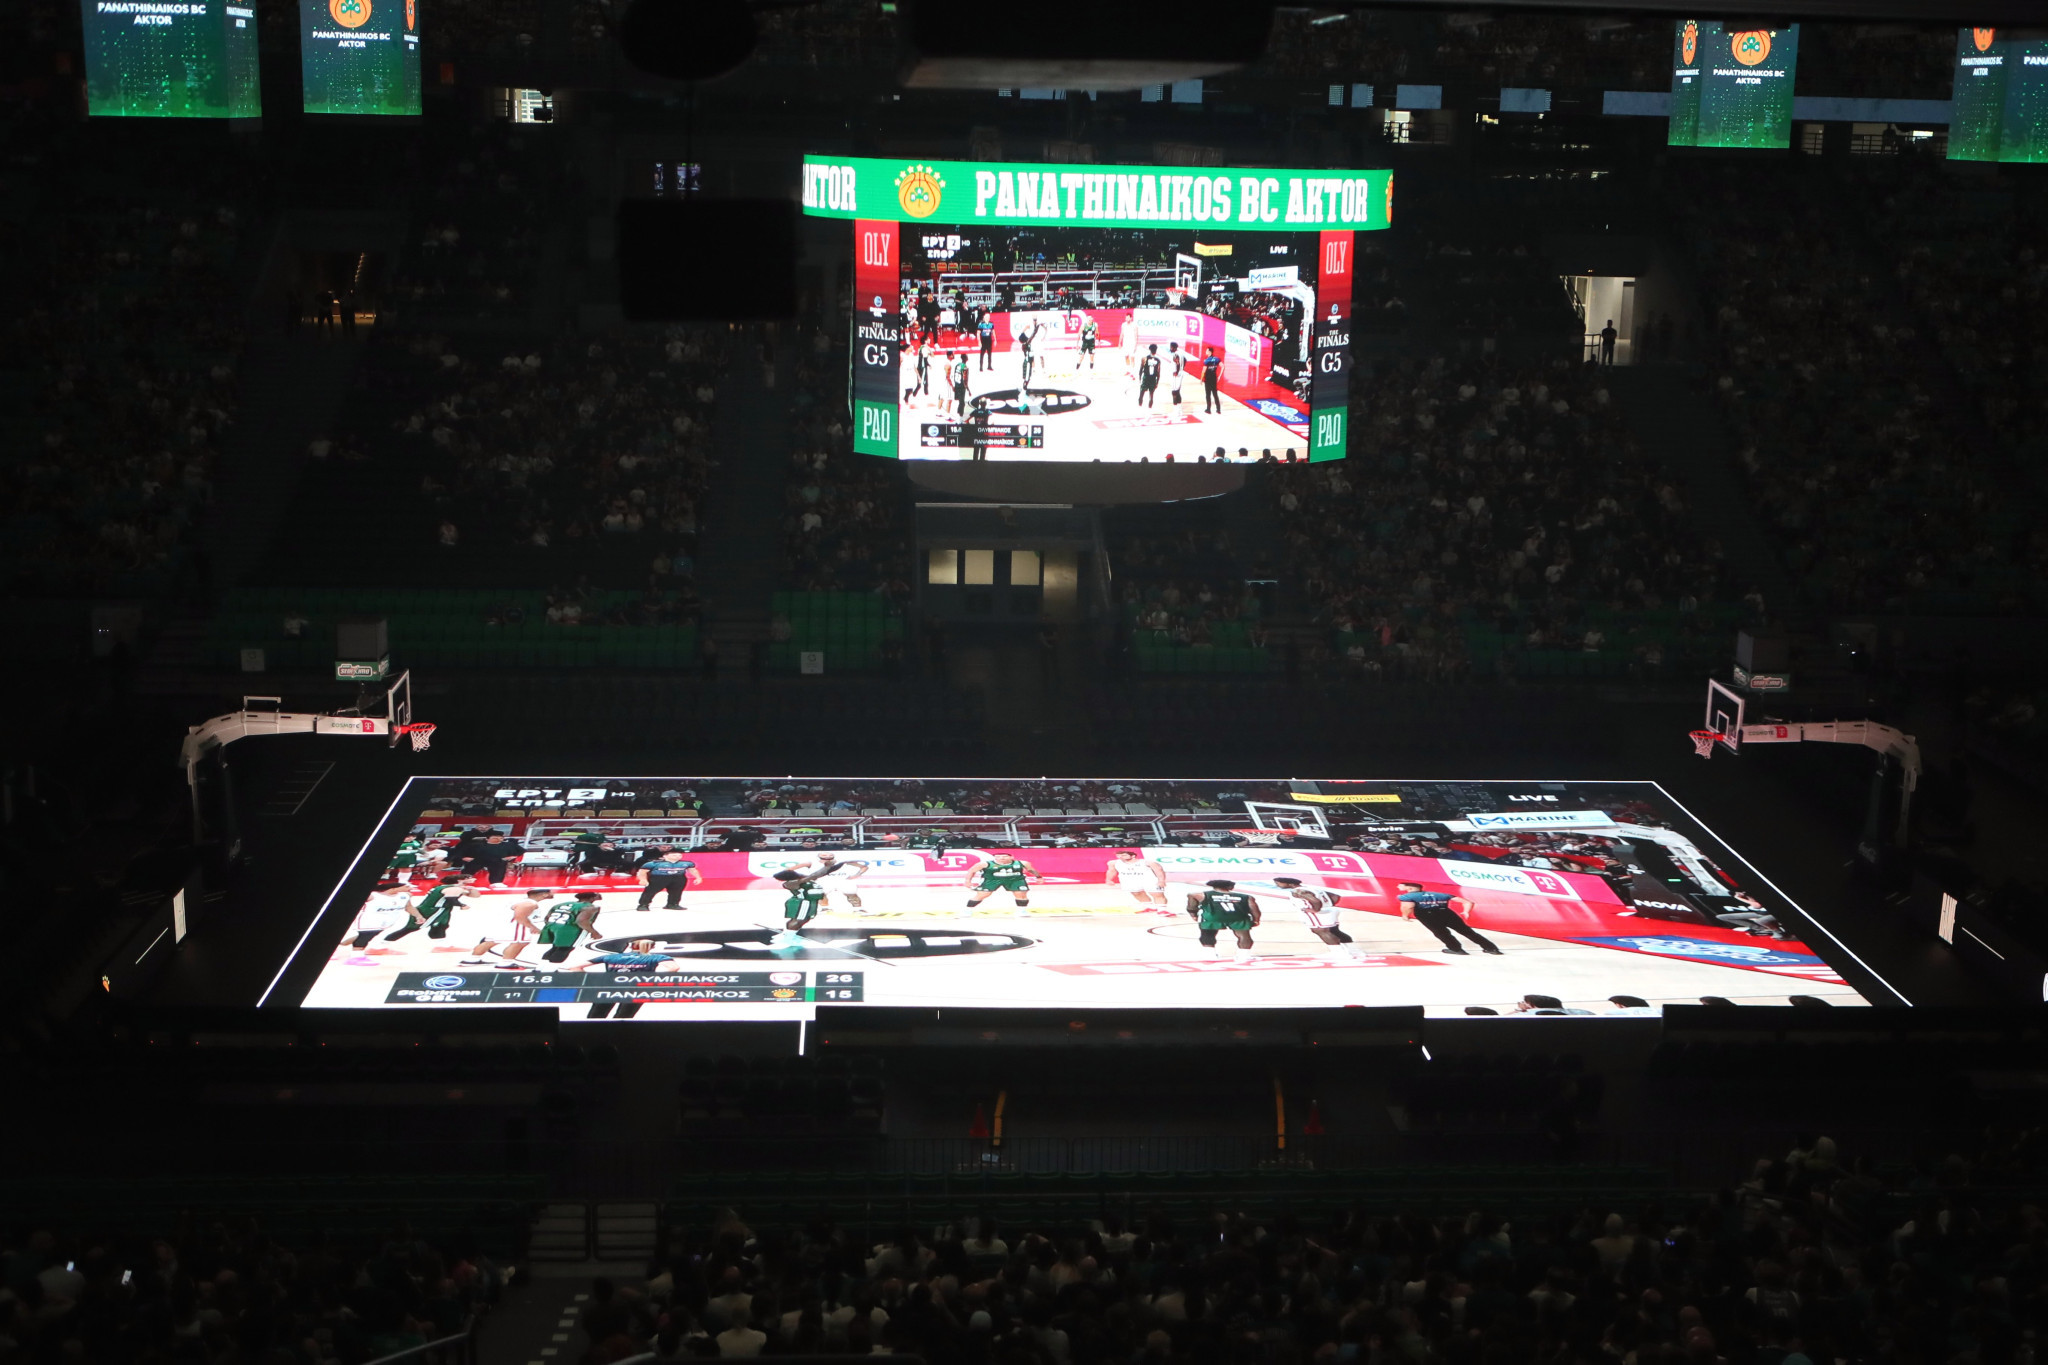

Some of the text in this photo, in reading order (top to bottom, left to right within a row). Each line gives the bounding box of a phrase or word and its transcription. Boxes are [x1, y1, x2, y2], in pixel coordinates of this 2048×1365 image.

[97, 2, 206, 15] PANATHINAIKOS BC
[133, 15, 173, 25] AKTOR
[312, 31, 390, 41] PANATHINAIKOS BC
[338, 40, 366, 48] AKTOR
[1713, 69, 1773, 77] PANATHINAIKOS
[974, 170, 1369, 224] PANATHINAIKOS BC AKTOR
[961, 239, 971, 247] HD
[864, 232, 891, 266] OLY
[1270, 245, 1288, 254] LIVE
[1326, 241, 1348, 275] OLY
[858, 326, 898, 342] FINALS
[1317, 333, 1350, 348] FINALS
[863, 343, 889, 367] G5
[1321, 352, 1342, 373] G5
[863, 406, 890, 442] PAO
[1317, 413, 1341, 447] PAO
[578, 790, 595, 798] 2
[1508, 794, 1560, 802] LIVE
[1508, 814, 1580, 823] MARINE
[1156, 856, 1297, 865] COSMOTE
[1450, 869, 1526, 885] COSMOTE
[1633, 898, 1693, 913] NOVA
[547, 912, 570, 925] 22
[512, 975, 553, 984] 15.8
[614, 975, 740, 983] ΟΛΥΜΠΙΑΚΟΣ
[825, 974, 853, 983] 26
[597, 990, 750, 999] ΠΑΝΑΘΗΝΑΪΚΟΣ
[825, 989, 852, 999] 15
